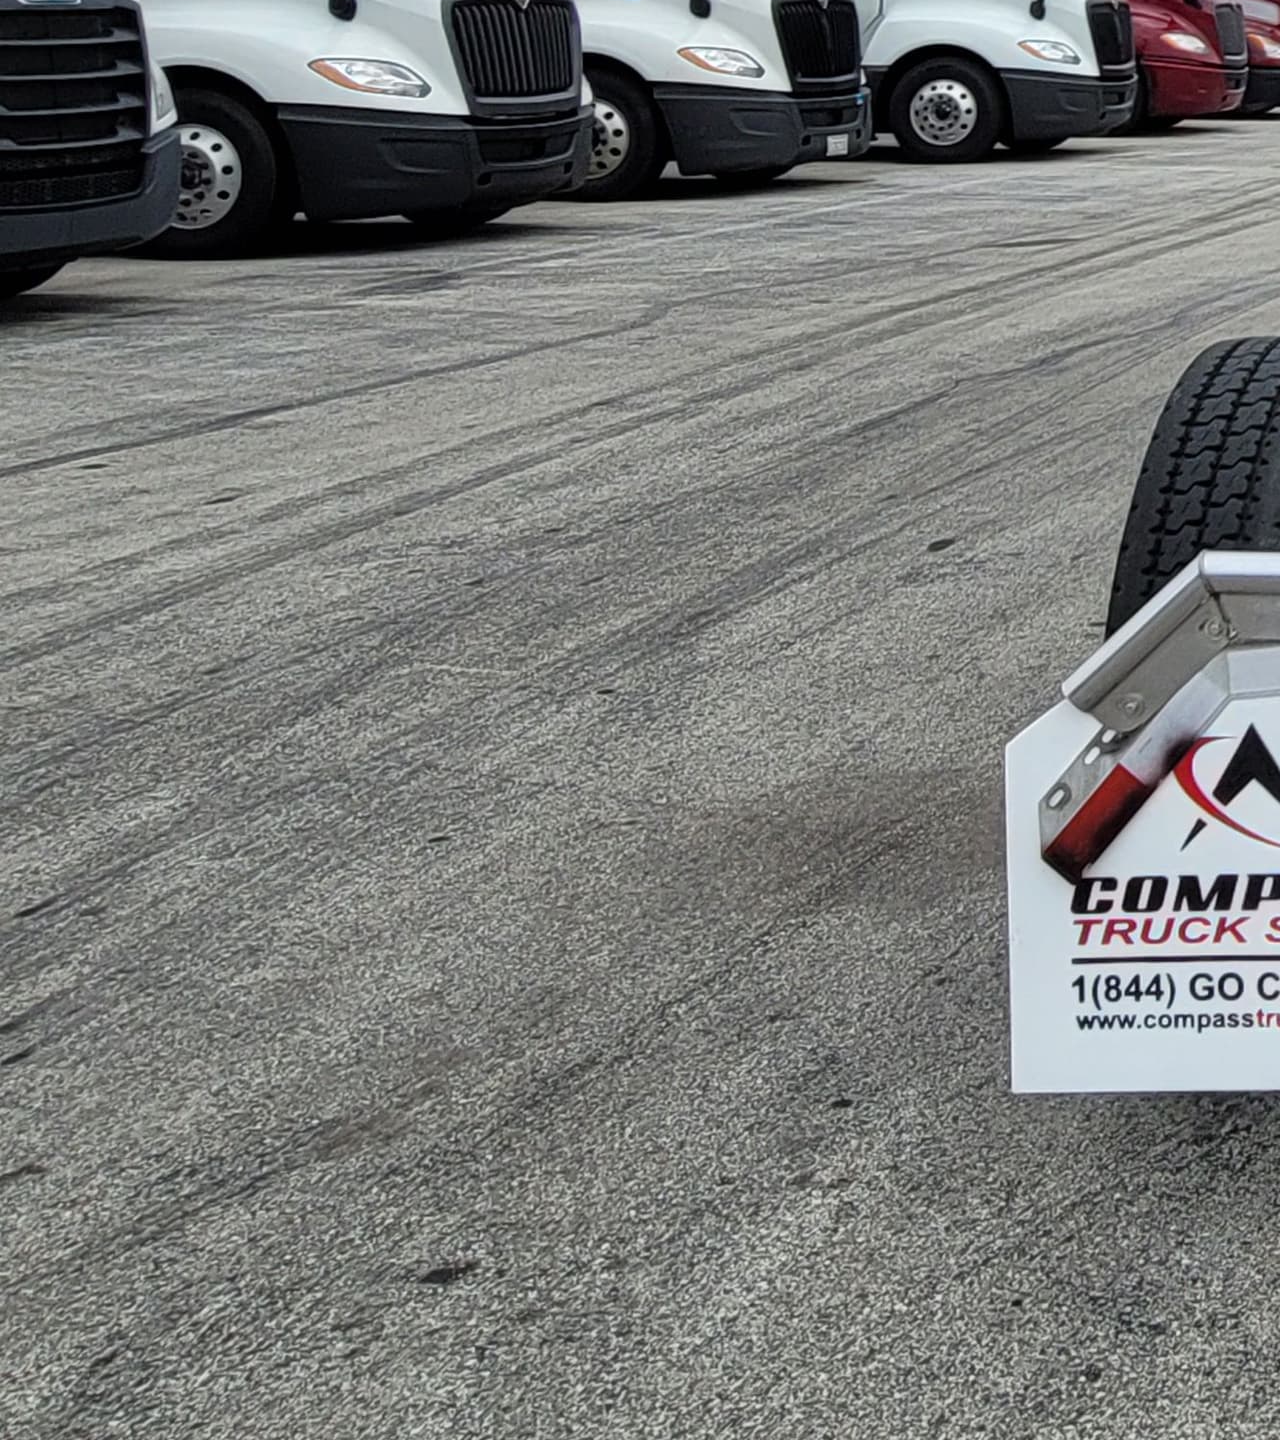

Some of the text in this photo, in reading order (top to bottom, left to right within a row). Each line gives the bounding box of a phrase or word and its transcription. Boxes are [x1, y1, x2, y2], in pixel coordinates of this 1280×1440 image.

[1073, 916, 1250, 946] TRUCK
[1071, 972, 1176, 1010] 1(844)
[1189, 971, 1245, 1002] GO
